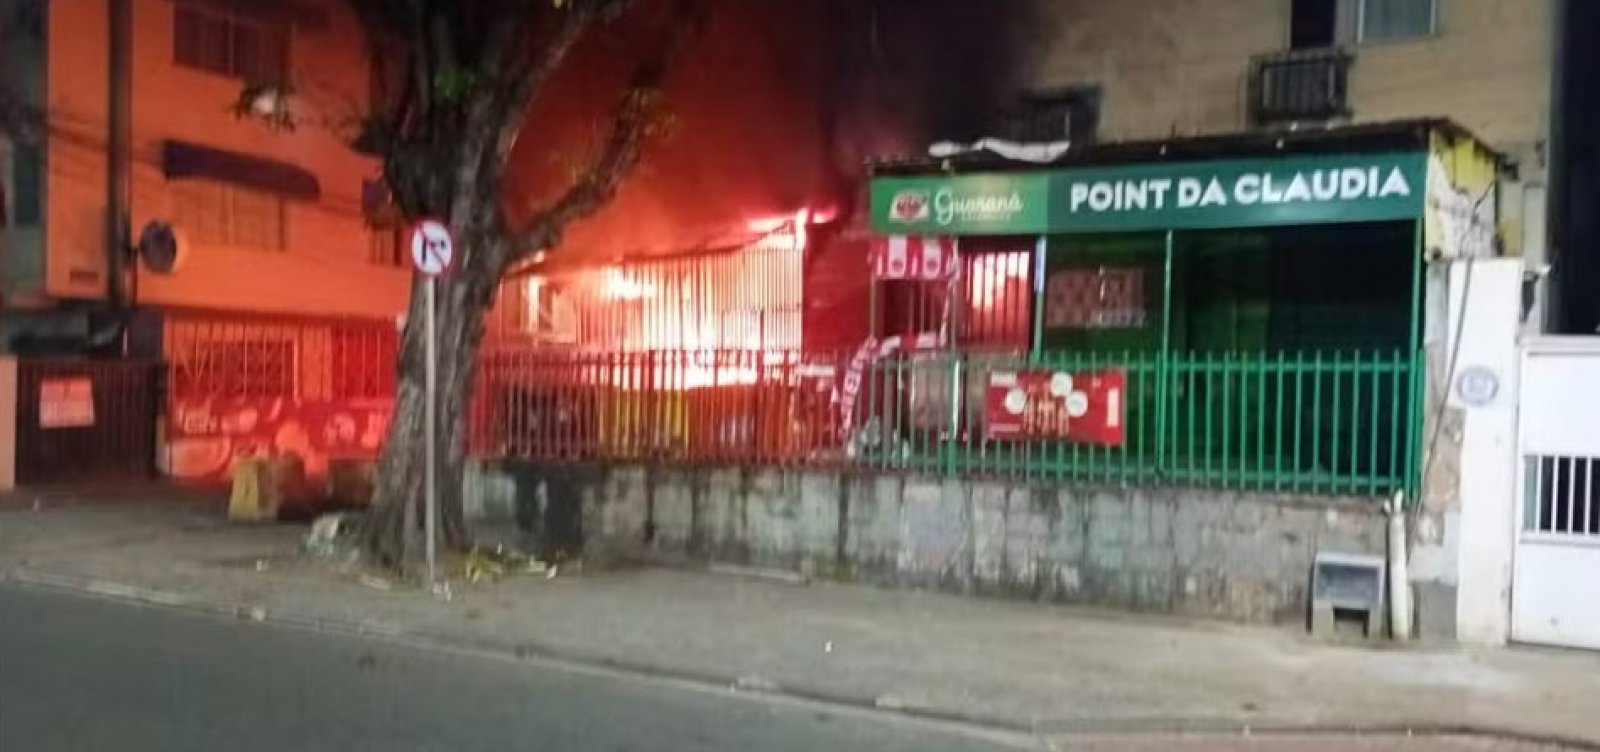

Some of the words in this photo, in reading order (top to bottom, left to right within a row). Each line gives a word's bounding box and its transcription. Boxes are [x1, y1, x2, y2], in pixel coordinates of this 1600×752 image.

[1070, 178, 1171, 213] POINT
[1178, 175, 1227, 208] DA
[1234, 165, 1411, 206] CLAUDIA
